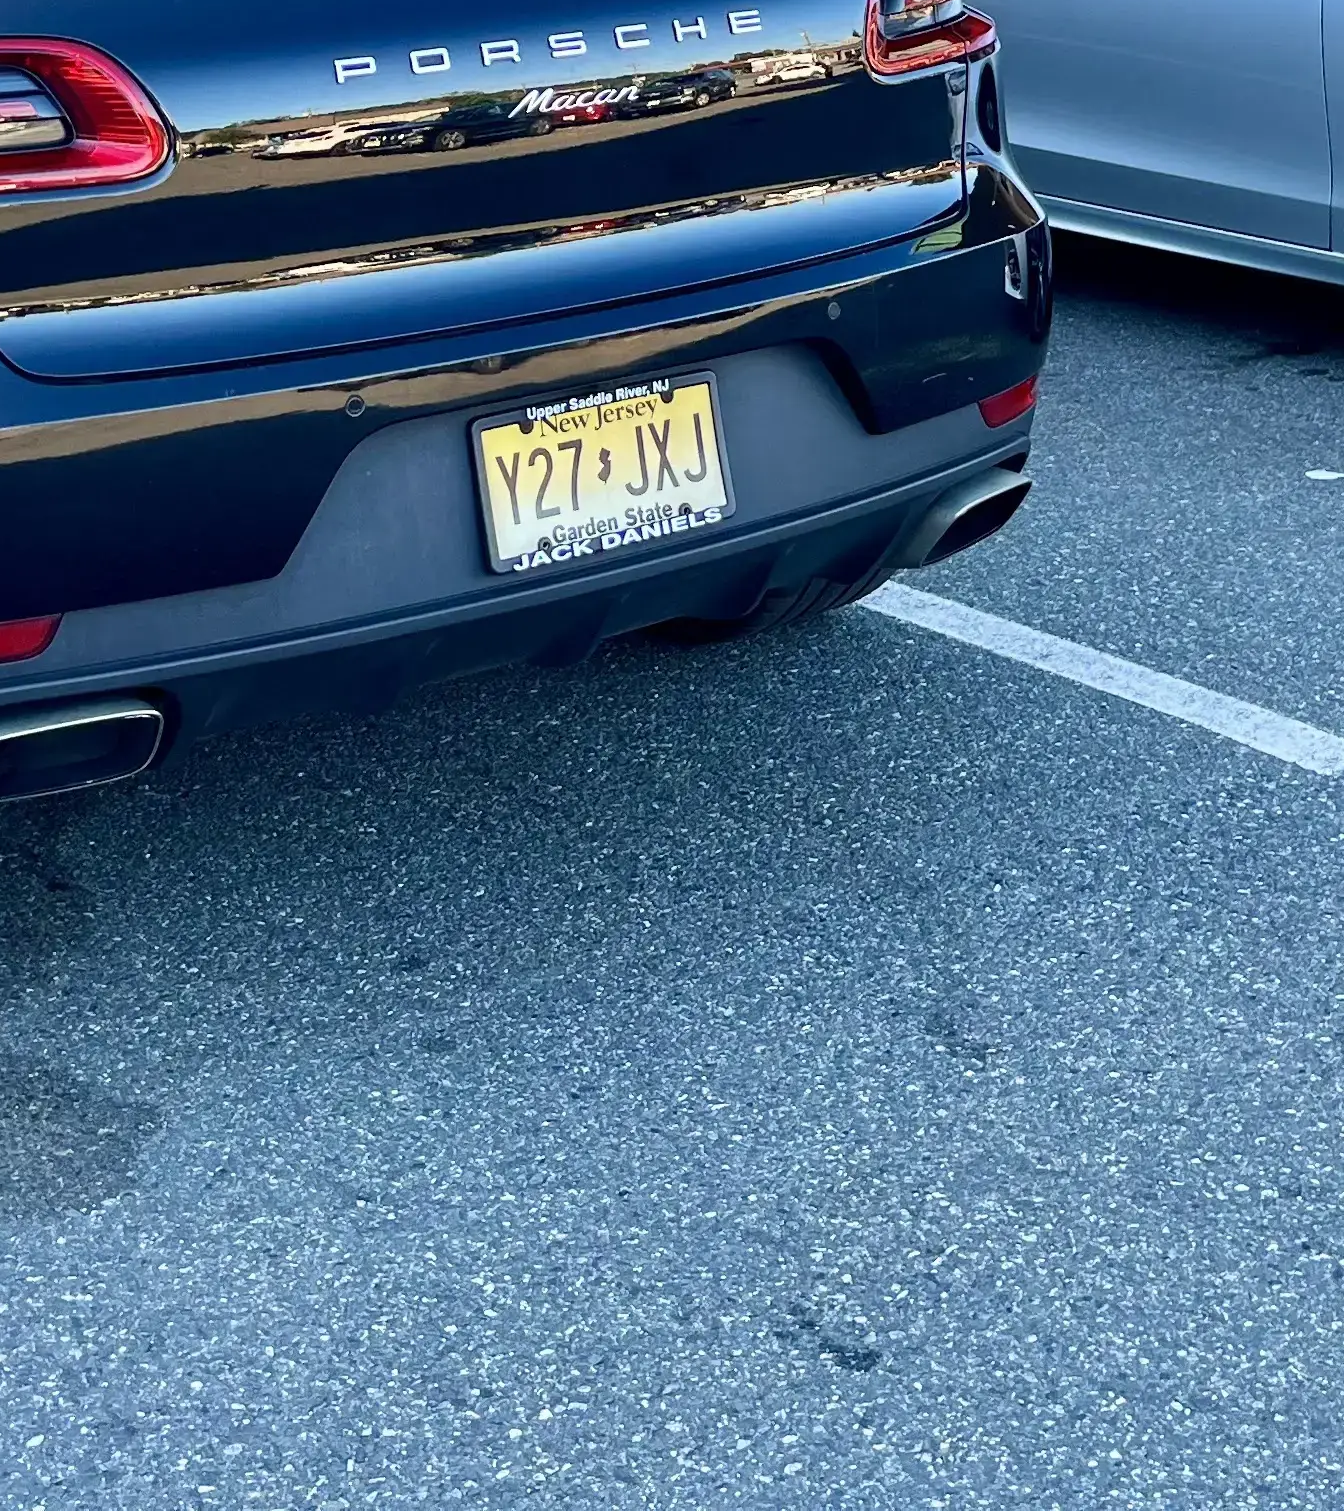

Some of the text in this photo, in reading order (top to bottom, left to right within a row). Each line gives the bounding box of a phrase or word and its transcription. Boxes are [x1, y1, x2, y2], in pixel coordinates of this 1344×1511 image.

[333, 9, 763, 85] PORSCHE
[508, 85, 642, 119] Macan
[526, 378, 670, 420] Upper Saddle River, NJ
[540, 398, 658, 437] New Jersey
[495, 412, 708, 525] Y27 JXJ
[513, 506, 723, 572] JACK DANIELS
[552, 502, 673, 544] Garden State
